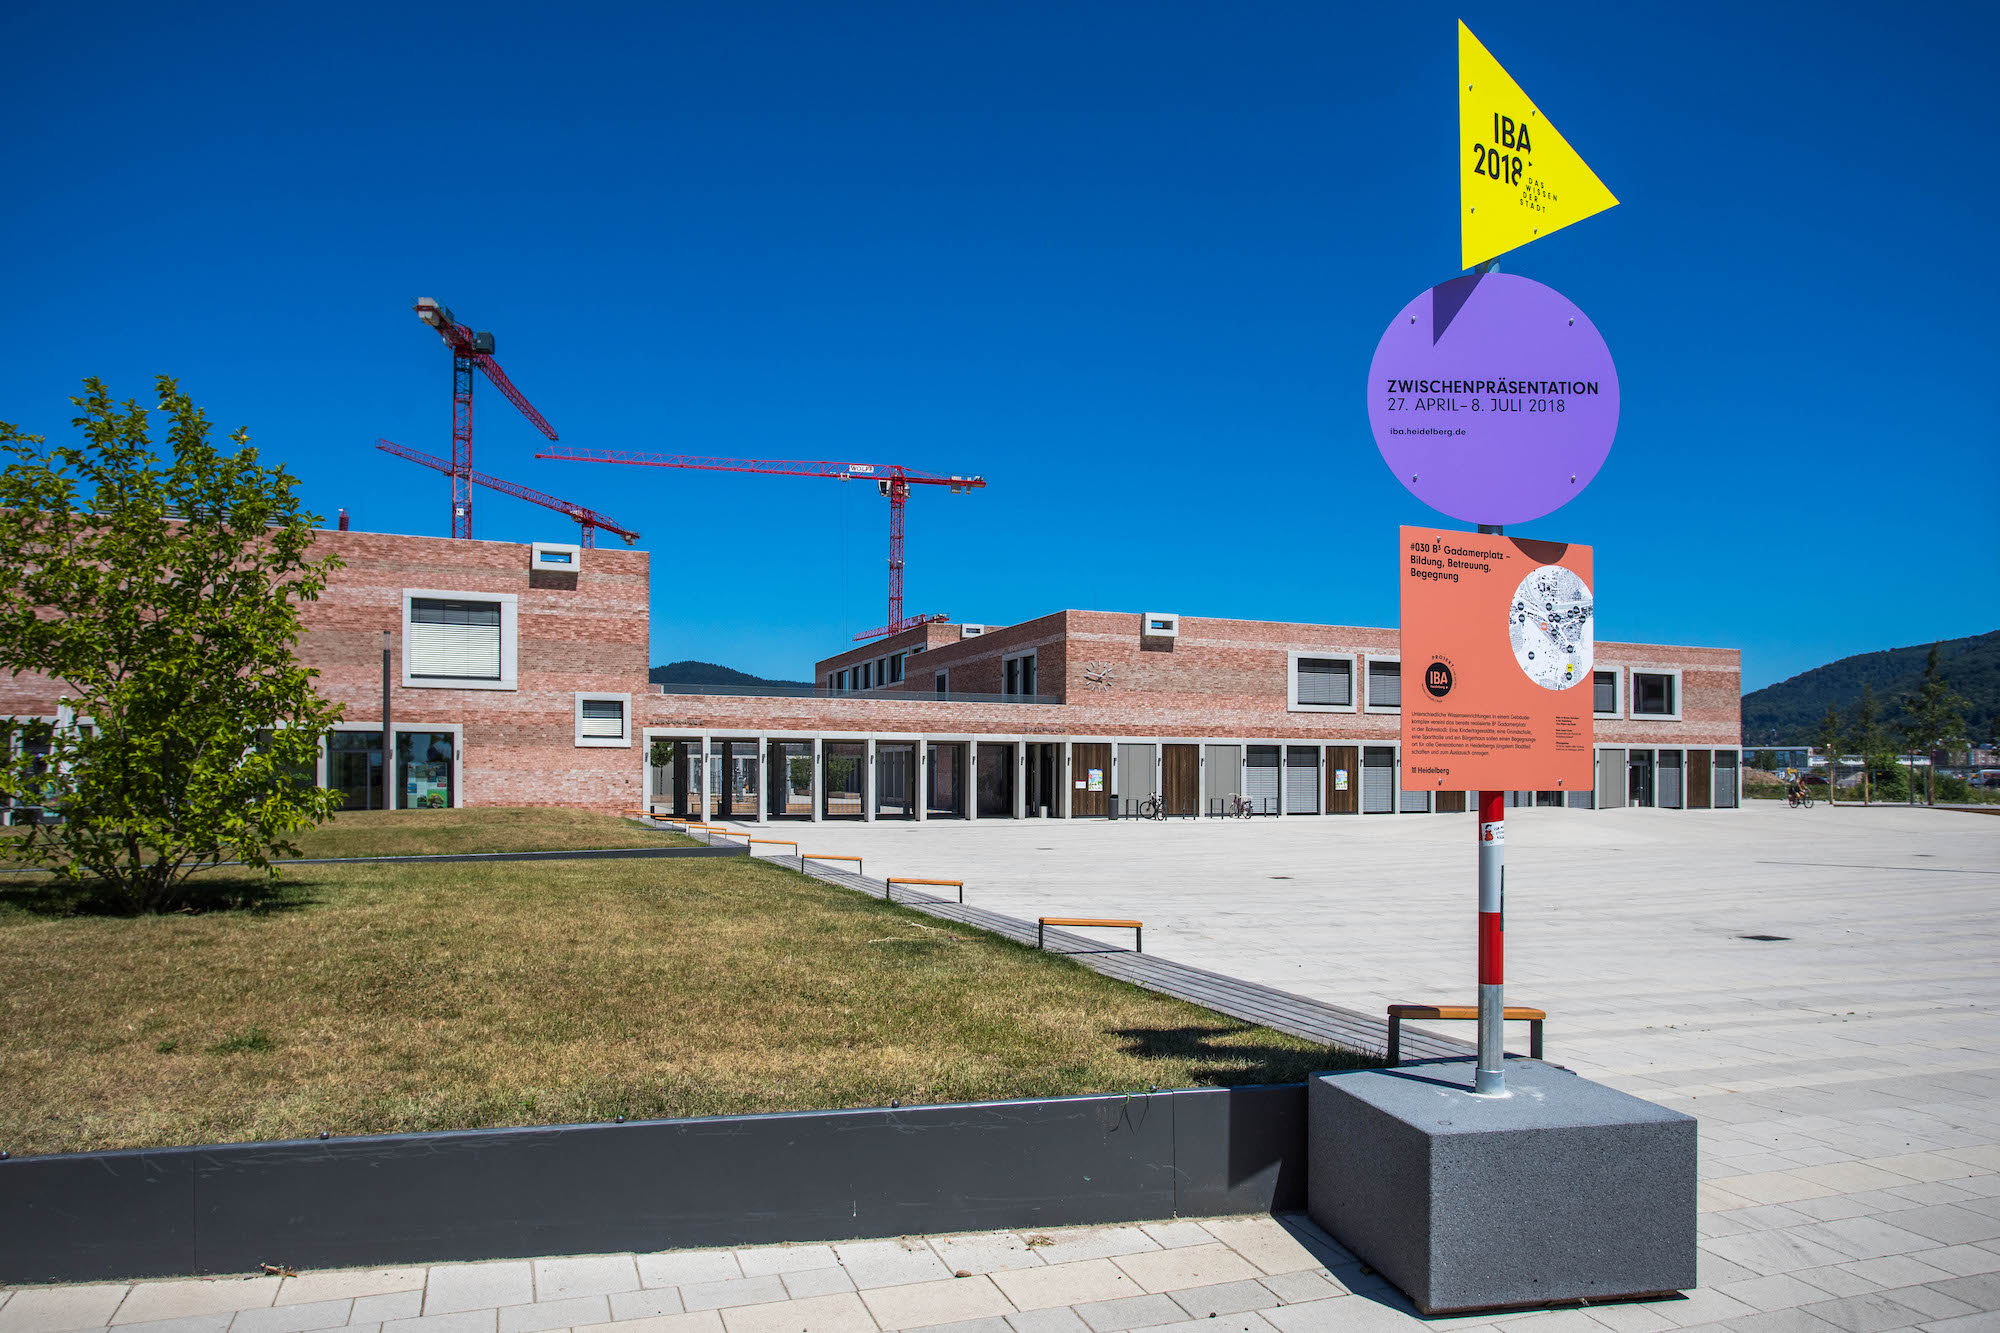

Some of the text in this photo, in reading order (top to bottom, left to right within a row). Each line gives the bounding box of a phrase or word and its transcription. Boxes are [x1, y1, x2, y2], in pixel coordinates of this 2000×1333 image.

[1494, 112, 1532, 154] IBA
[1473, 143, 1523, 187] 2018
[1528, 177, 1545, 189] DAS
[1522, 191, 1539, 202] DER
[1525, 184, 1558, 201] WISSEN
[1519, 198, 1546, 213] STADT
[1387, 377, 1599, 395] ZWISCHENPRÄSENTATION
[1387, 397, 1409, 411] 27.
[1471, 398, 1485, 412] 8.
[1490, 398, 1522, 412] JULI
[1528, 398, 1566, 413] 2018
[1390, 427, 1467, 438] iba.heidelberg.de
[1410, 542, 1430, 553] #030
[1443, 545, 1504, 561] Gadamerplatz
[1410, 555, 1492, 573] Bildung, Betreuung,
[1410, 567, 1459, 583] Begegnung
[1431, 654, 1455, 668] PROJEKT
[1430, 671, 1448, 685] IBA
[1417, 766, 1450, 775] Heidelberg
